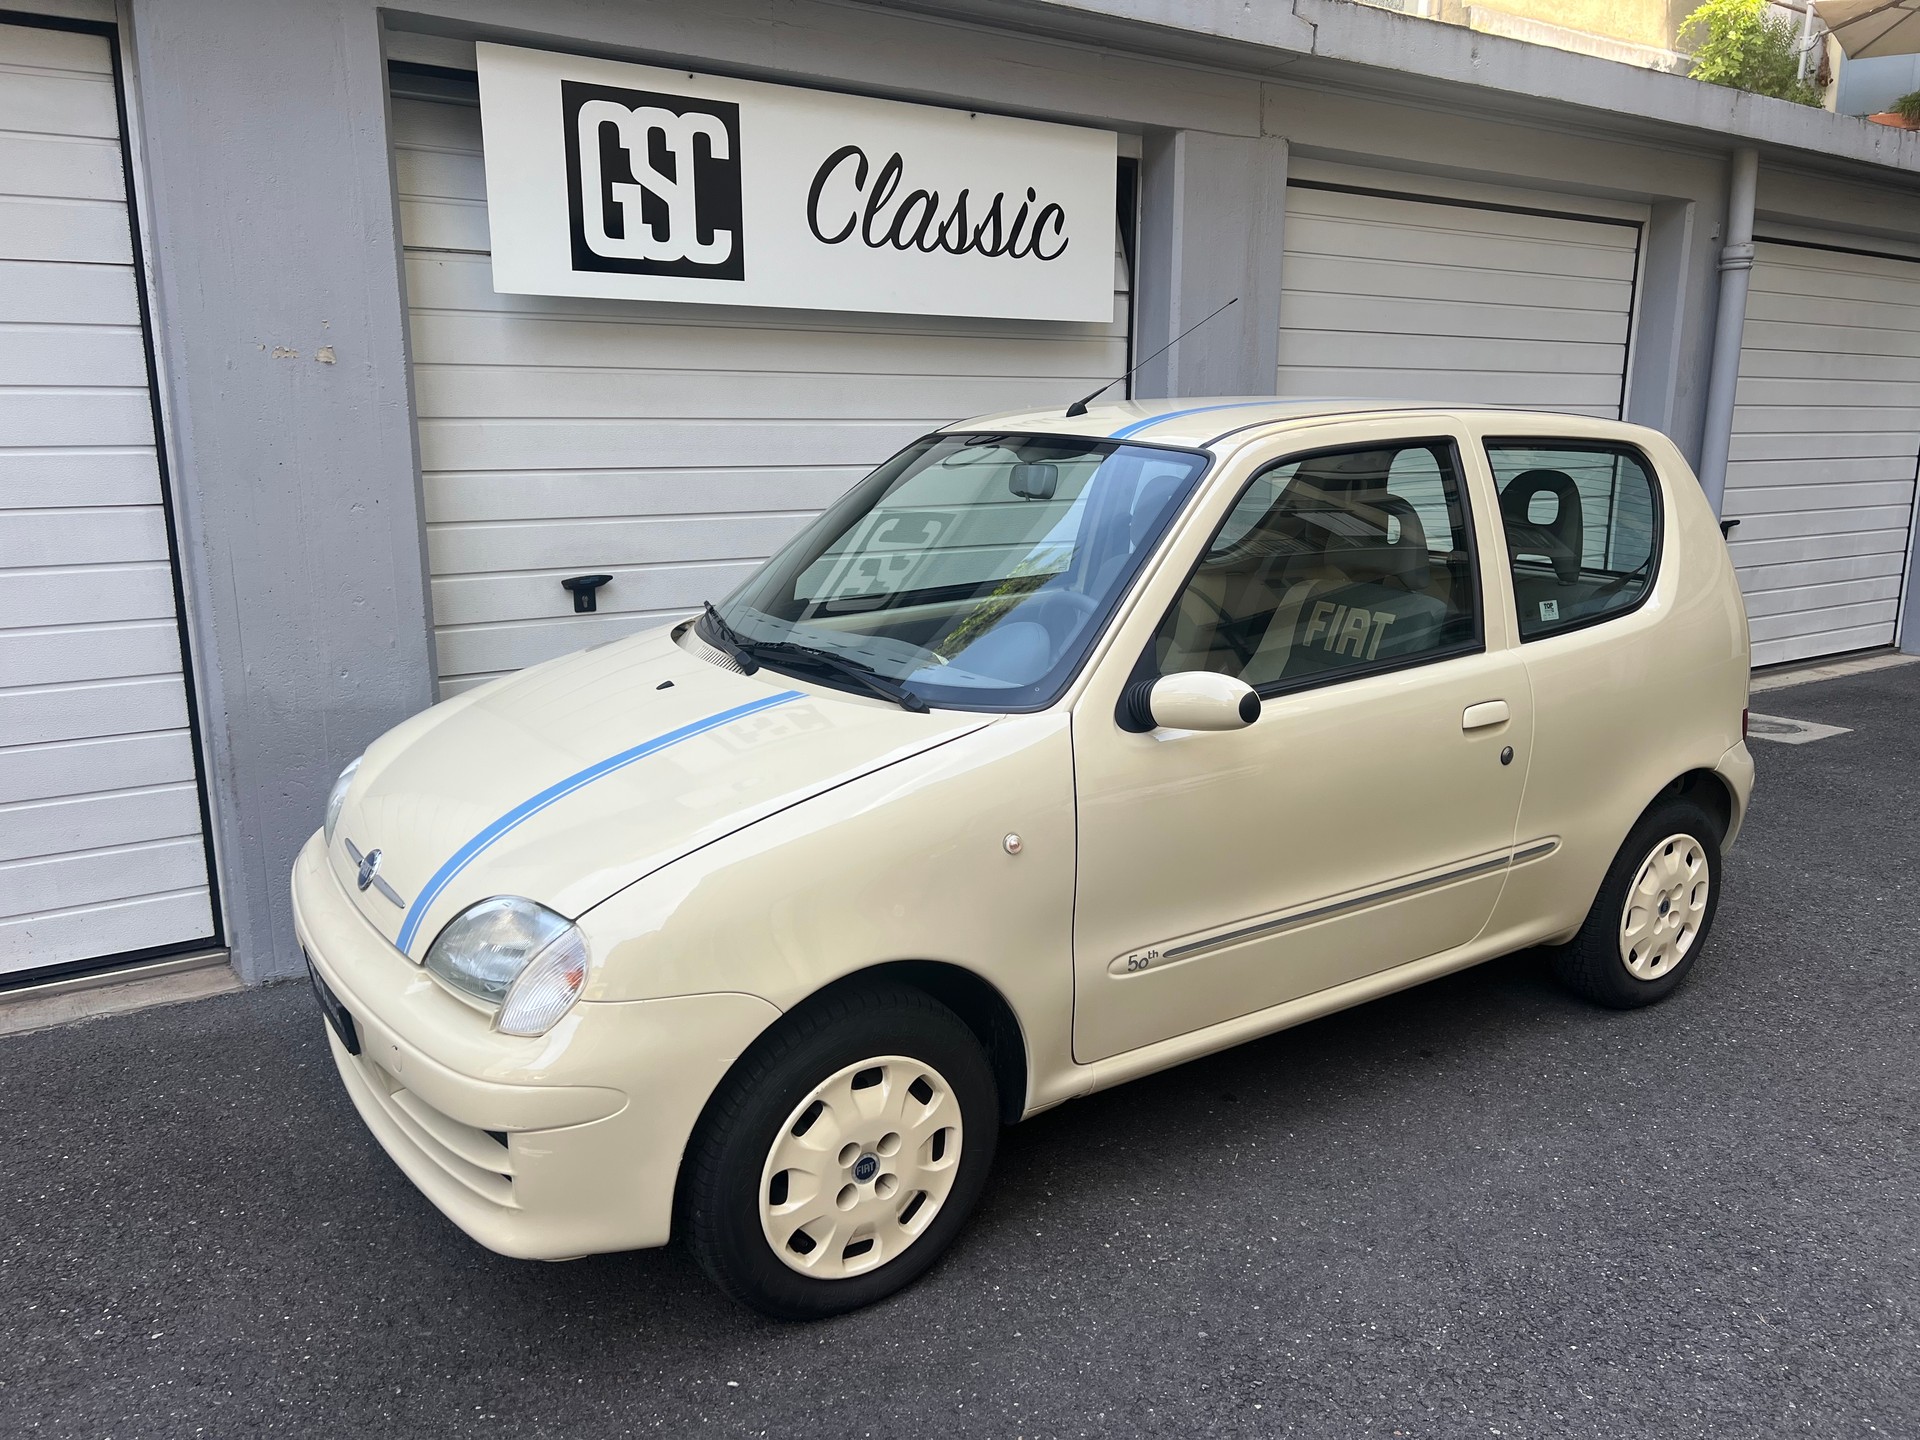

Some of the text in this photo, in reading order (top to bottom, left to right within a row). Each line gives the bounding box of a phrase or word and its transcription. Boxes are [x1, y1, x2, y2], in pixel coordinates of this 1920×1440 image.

[578, 100, 1070, 264] GSC Classic
[1303, 601, 1396, 660] FIAT
[856, 1161, 875, 1176] FIAT
